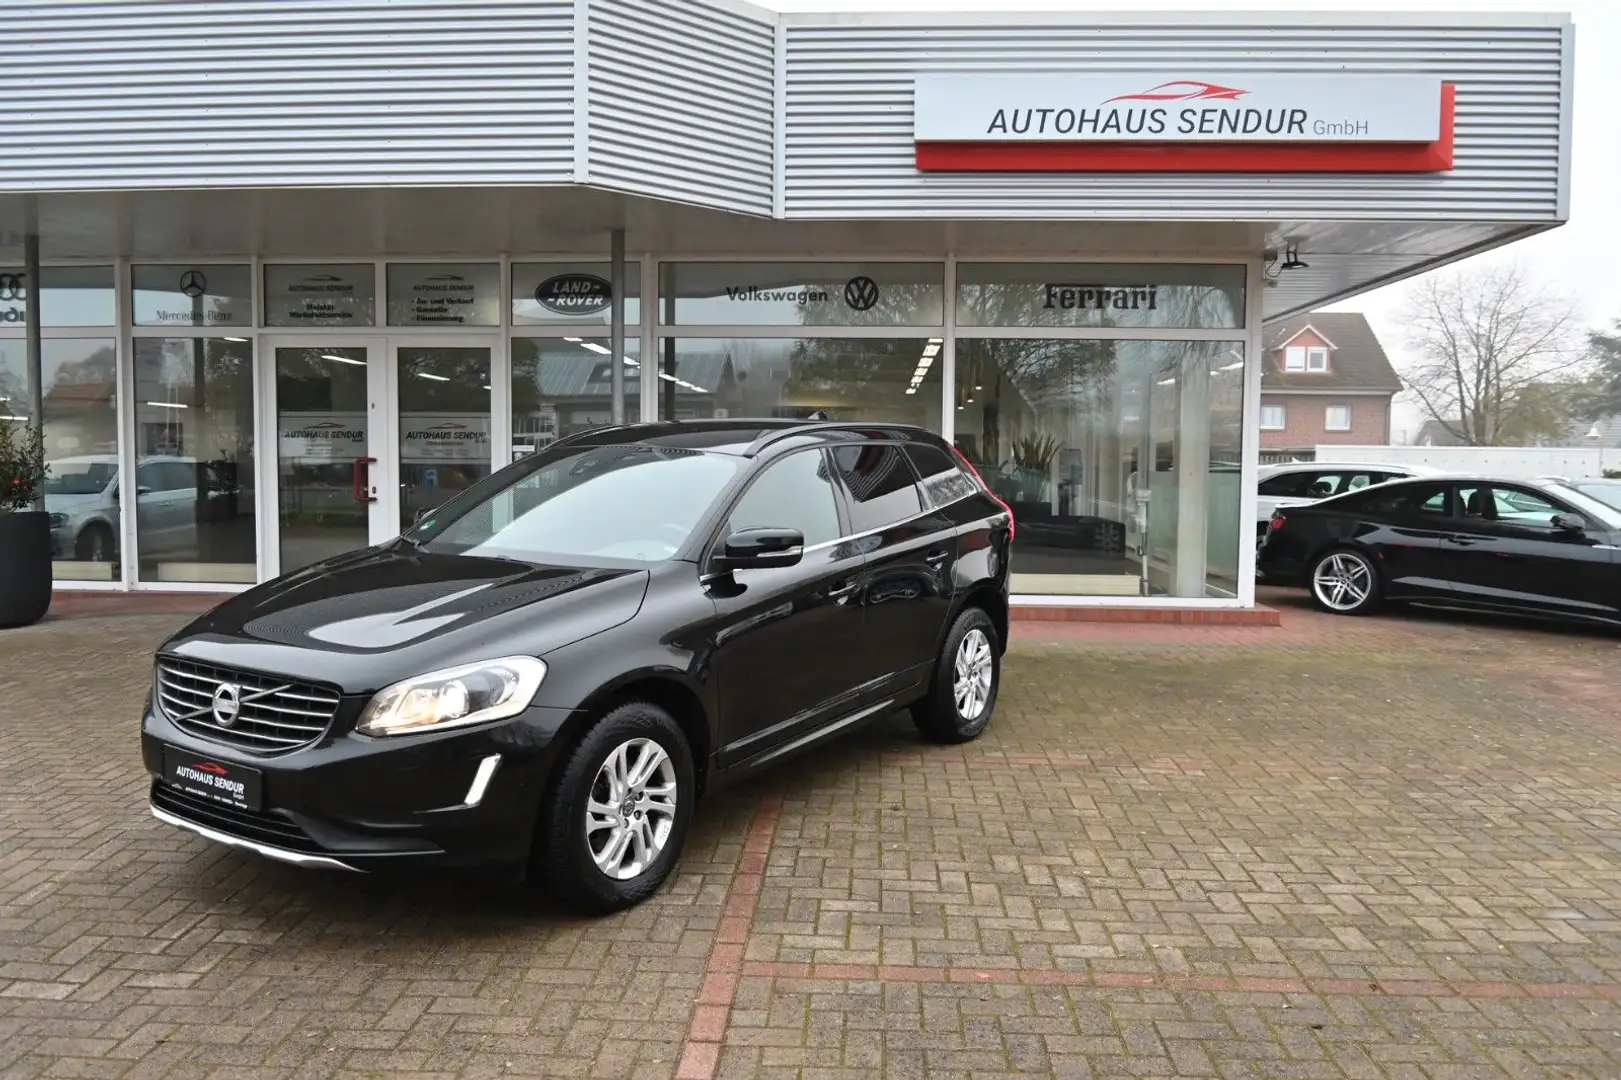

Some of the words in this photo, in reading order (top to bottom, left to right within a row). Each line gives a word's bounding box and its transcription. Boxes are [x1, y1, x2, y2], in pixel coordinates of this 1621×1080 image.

[987, 108, 1167, 135] AUTOHAUS
[1177, 108, 1308, 135] SENDUR
[1313, 118, 1370, 136] GmbH
[552, 282, 591, 294] LAND
[556, 295, 604, 306] ROVER
[726, 286, 828, 305] Volkswagen
[1043, 283, 1157, 310] Ferrari
[155, 309, 233, 321] Mercedes-Benz
[285, 430, 329, 439] AUTOHAUS
[331, 430, 364, 439] SENDUR
[406, 431, 452, 440] AUTOHAUS
[176, 765, 213, 785] AUTOHAUS
[214, 777, 244, 794] SENDUR
